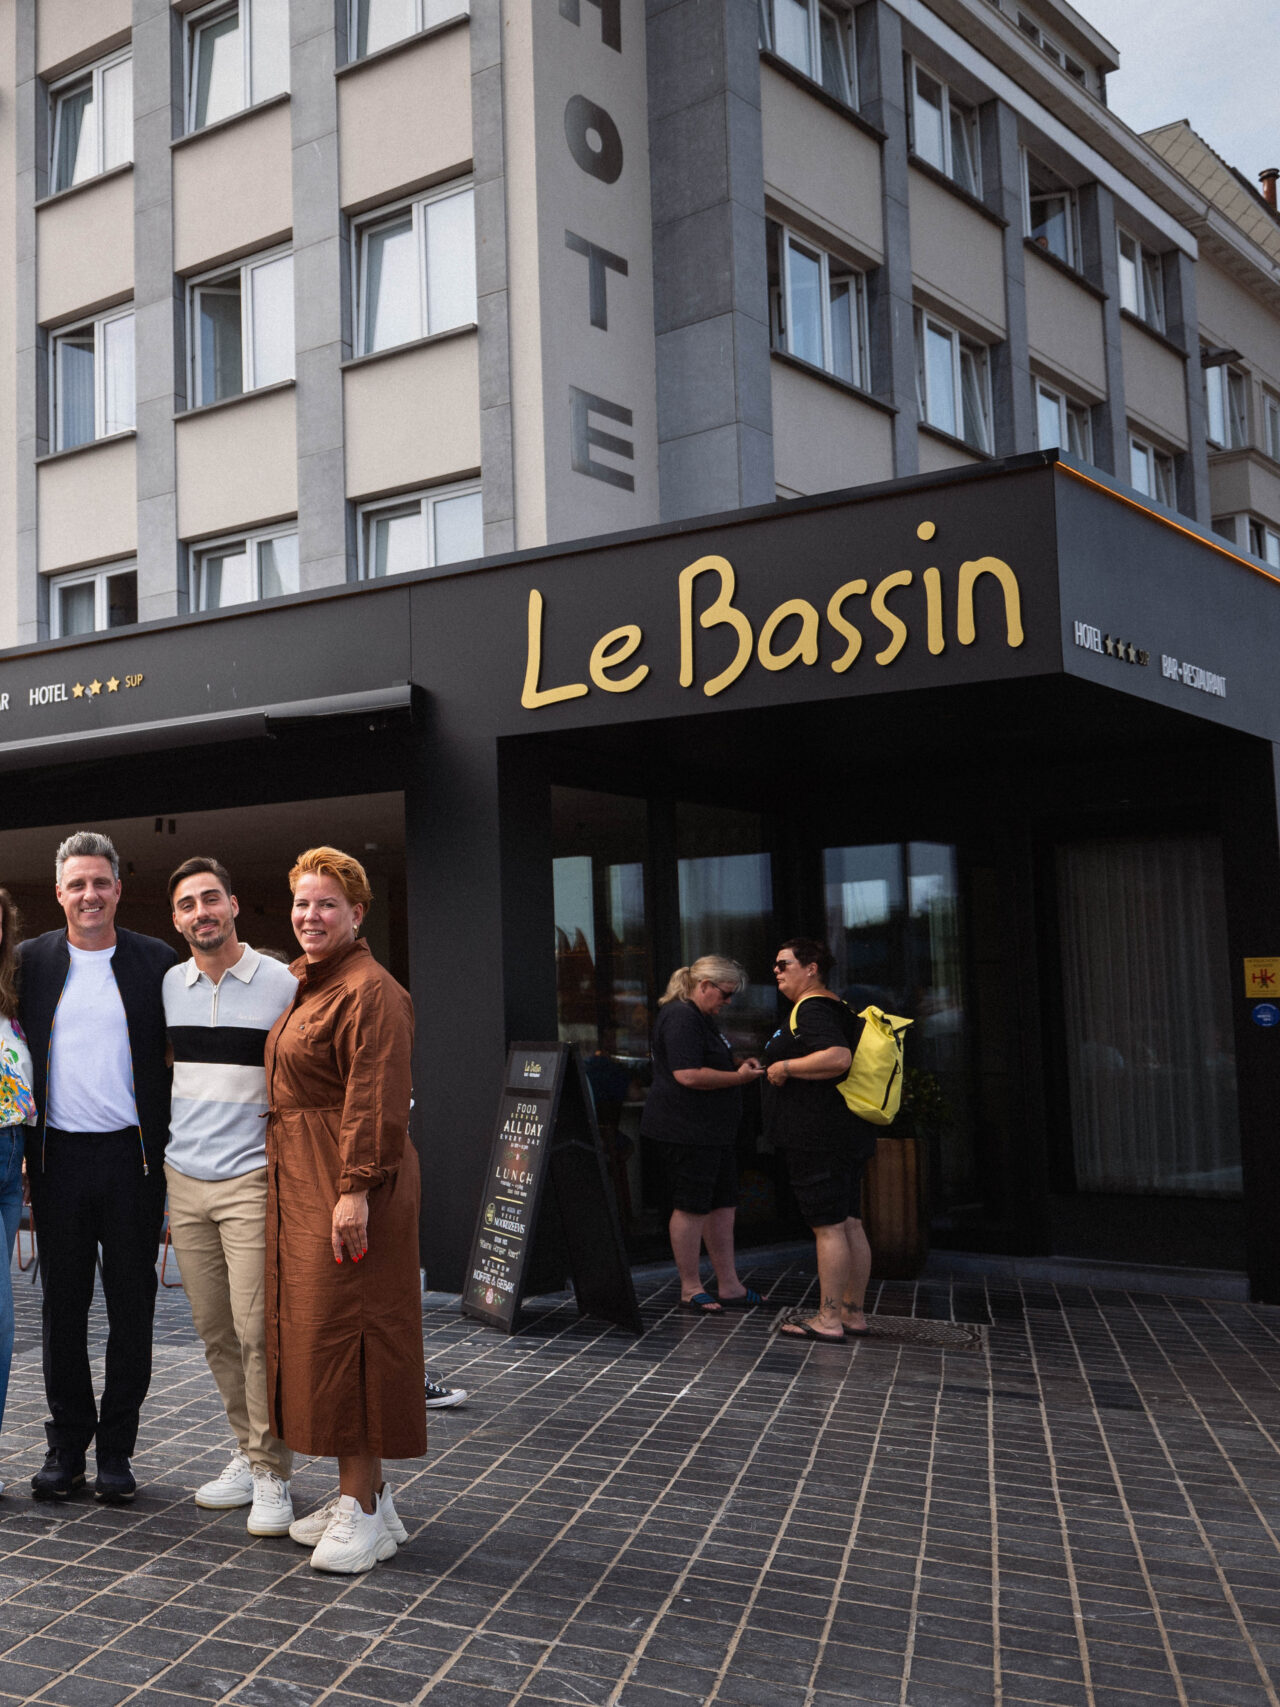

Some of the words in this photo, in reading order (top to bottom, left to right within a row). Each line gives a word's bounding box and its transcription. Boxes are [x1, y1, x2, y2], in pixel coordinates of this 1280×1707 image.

[521, 588, 650, 710] Le
[678, 520, 1024, 697] Bassin
[1073, 620, 1104, 654] HOTEL
[1161, 654, 1179, 681] BAR
[1182, 661, 1227, 698] RESTAURANT
[29, 683, 68, 706] HOTEL
[124, 673, 144, 689] SUP
[516, 1103, 537, 1115] FOOD
[503, 1119, 522, 1134] ALL
[524, 1122, 544, 1137] DAY
[500, 1133, 522, 1142] EVERY
[526, 1137, 540, 1146] DAY
[495, 1165, 534, 1185] LUNCH
[490, 1276, 496, 1286] &
